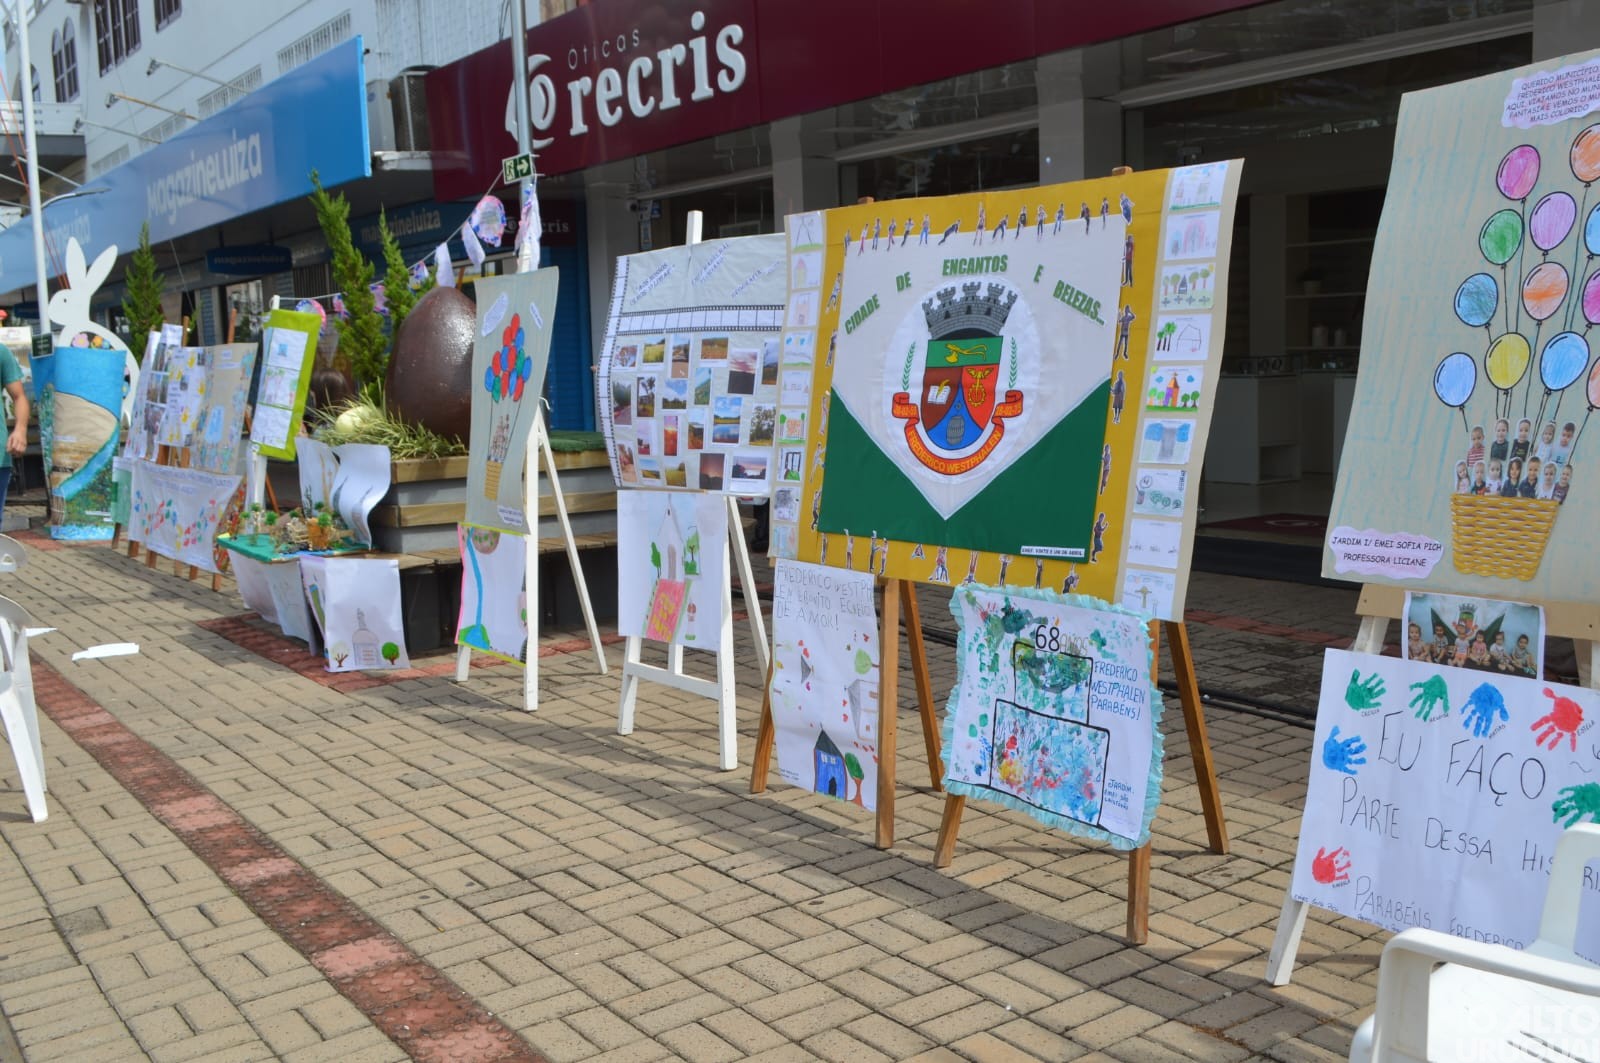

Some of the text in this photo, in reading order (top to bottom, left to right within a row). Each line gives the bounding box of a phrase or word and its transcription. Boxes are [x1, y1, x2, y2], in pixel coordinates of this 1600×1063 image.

[1518, 74, 1600, 100] FREDERICO WESTPHALE
[1521, 76, 1554, 90] QUERIDO
[1528, 92, 1567, 106] VIAJAMOS
[1567, 88, 1580, 97] NO
[1581, 83, 1600, 94] MUN
[1509, 105, 1544, 118] FANTASIA
[1553, 97, 1578, 109] VEMOS
[1588, 91, 1600, 102] MU
[1529, 103, 1589, 122] MAIS COLORIDO
[844, 294, 880, 335] CIDADE
[896, 271, 912, 293] DE
[942, 254, 1009, 277] ENCANTOS
[1033, 264, 1044, 283] E
[908, 430, 1001, 472] FREDERICO WESTPHALEN
[1332, 536, 1362, 546] JARDIM
[1374, 539, 1393, 548] EMEI
[1396, 541, 1421, 550] SOFIA
[1424, 542, 1442, 551] PICH
[1343, 552, 1427, 567] PROFESSORA LICIANE
[777, 565, 832, 590] FREDERICO
[776, 600, 840, 632] DE AMOR!
[1035, 624, 1060, 652] 68
[1094, 661, 1138, 682] FREDERICO
[1091, 680, 1146, 705] WESTPHALEN
[1378, 710, 1422, 771] EU
[1446, 739, 1546, 806] FAÇO
[1340, 776, 1400, 839] PARTE
[1424, 817, 1494, 865] DESSA
[1354, 875, 1432, 929] PARABÉNS
